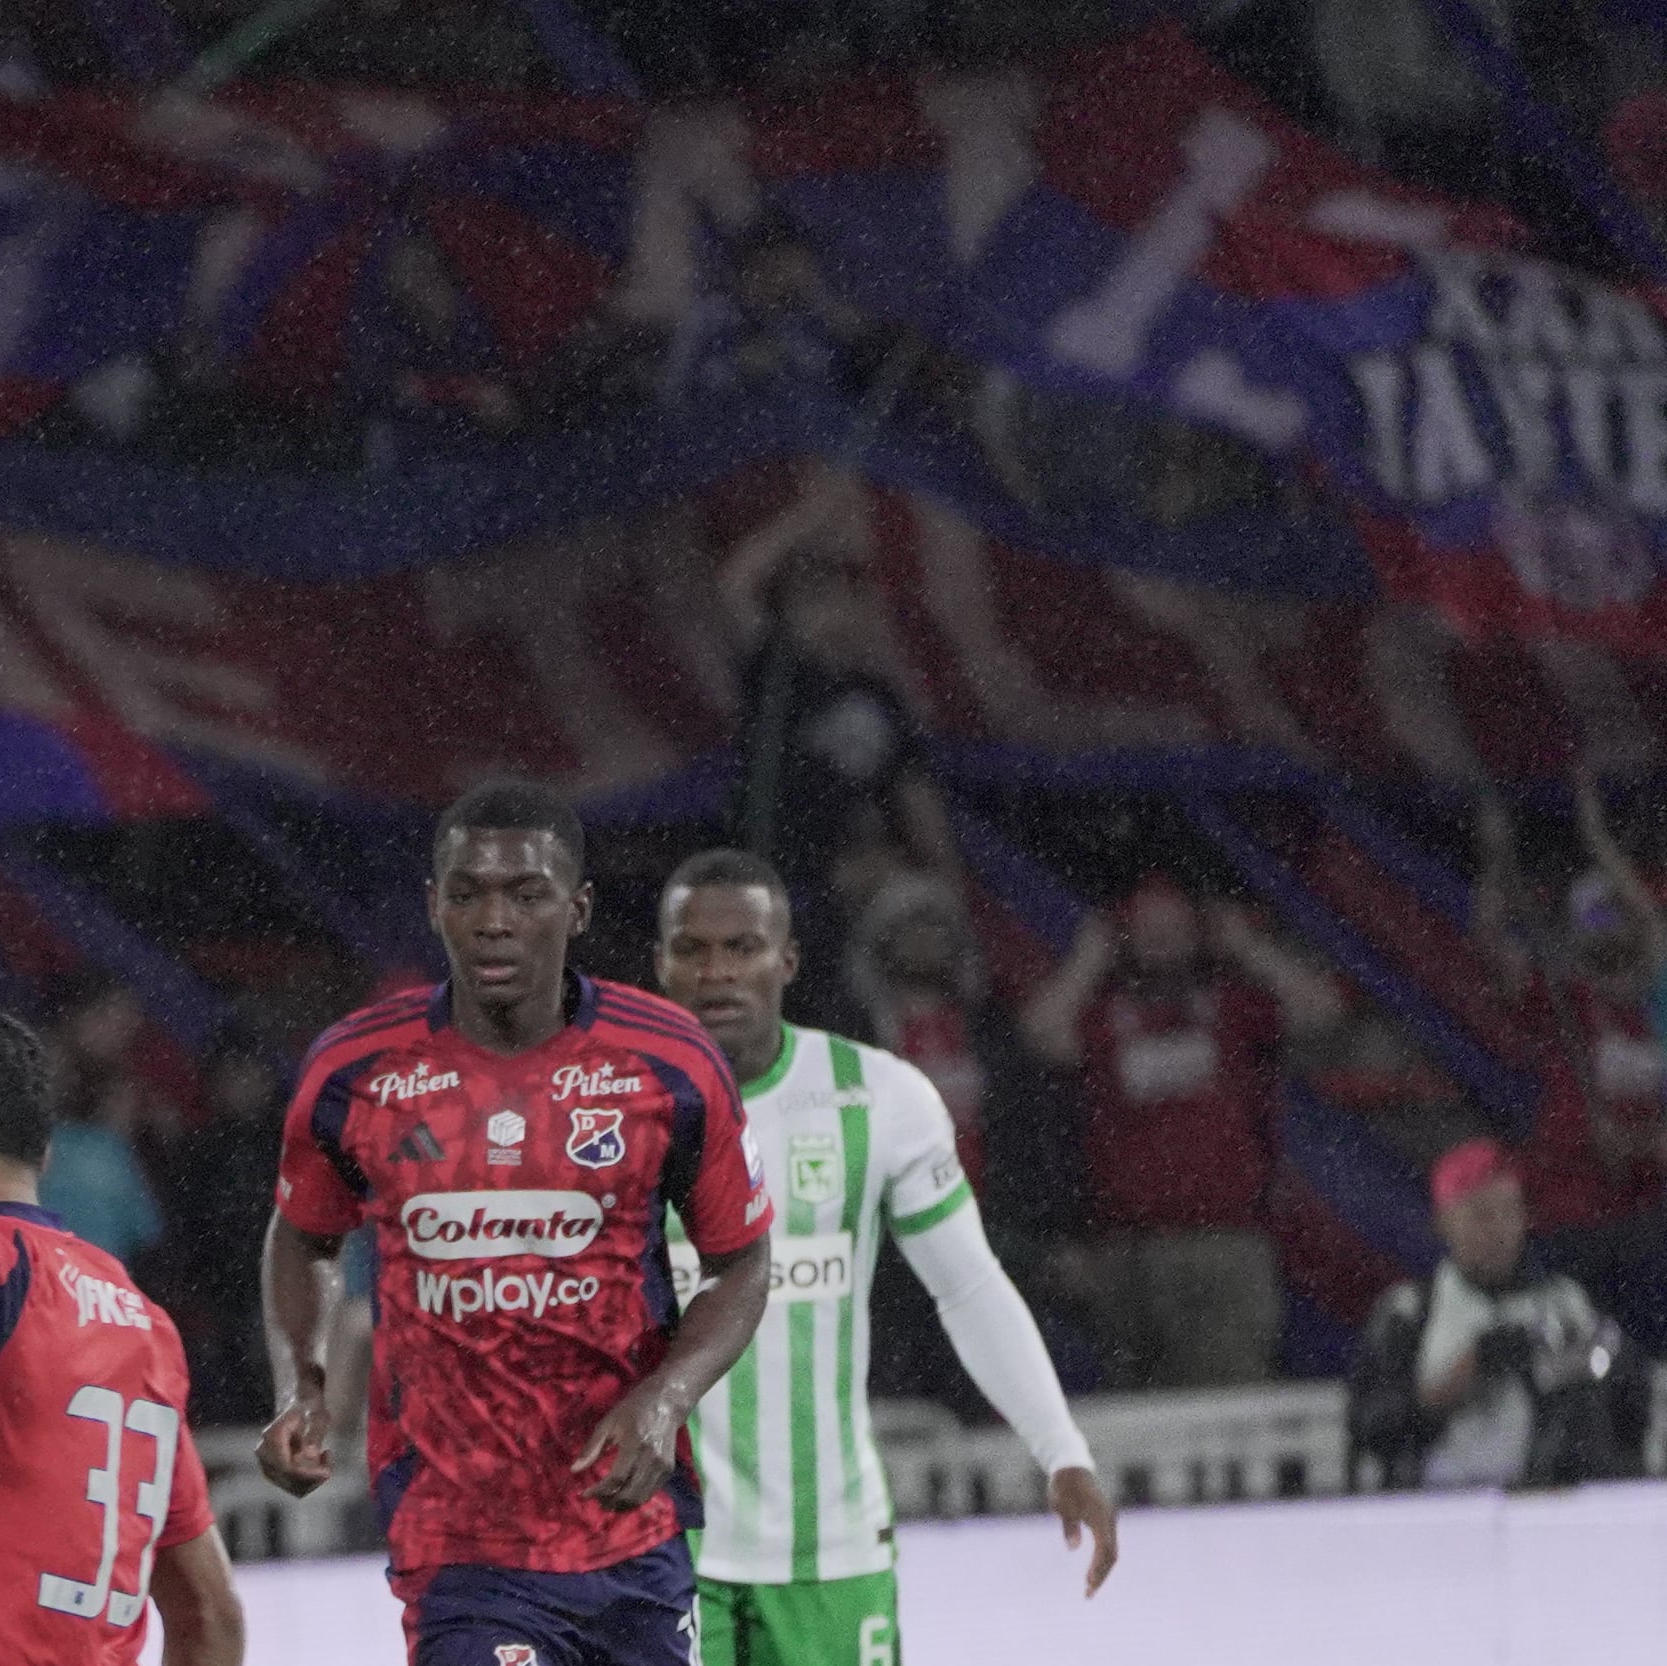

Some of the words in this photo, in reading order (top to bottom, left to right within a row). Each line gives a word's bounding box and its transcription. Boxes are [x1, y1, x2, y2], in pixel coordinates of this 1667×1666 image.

[370, 1068, 461, 1107] Pilsen
[552, 1064, 643, 1101] Pilsen
[407, 1206, 597, 1243] Colanta
[37, 1383, 180, 1628] 33
